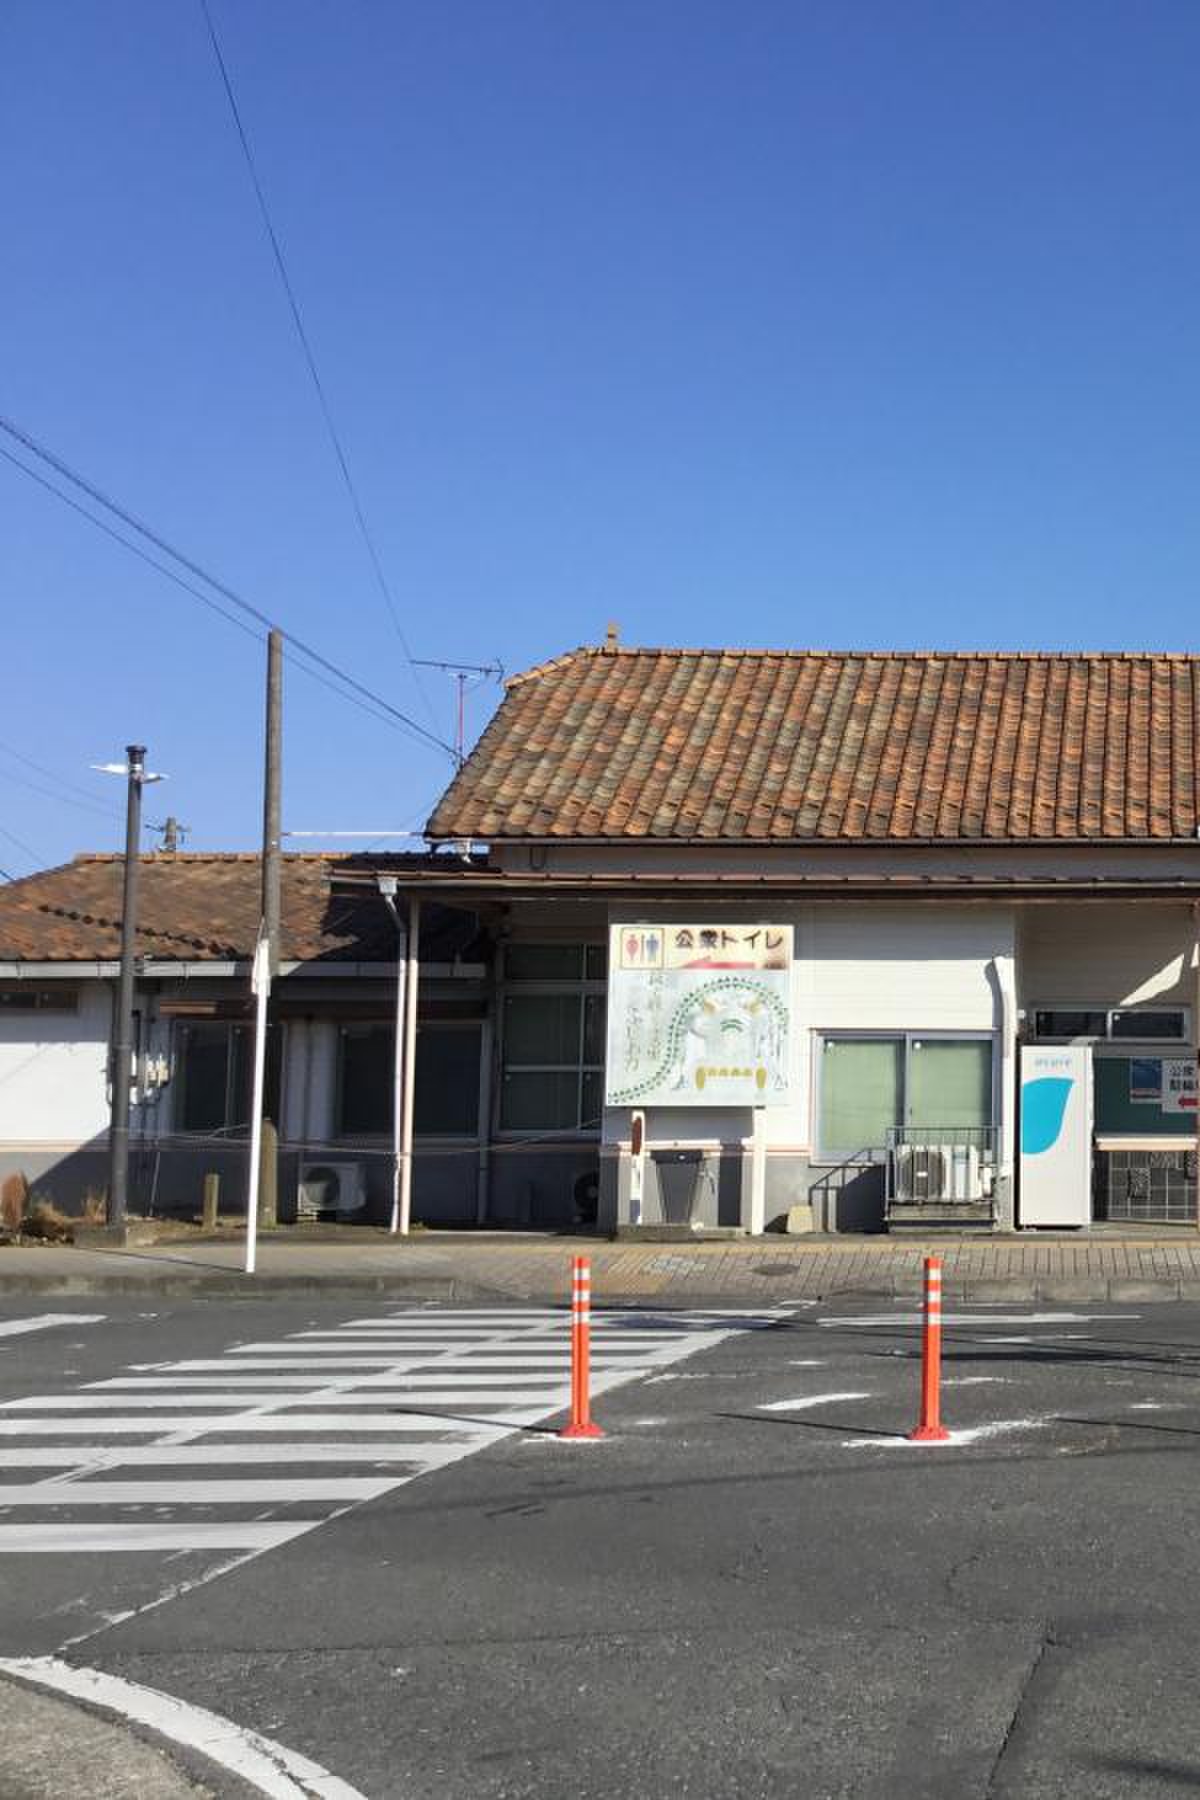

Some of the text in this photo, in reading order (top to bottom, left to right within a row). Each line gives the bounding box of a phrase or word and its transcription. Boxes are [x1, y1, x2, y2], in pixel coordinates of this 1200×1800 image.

[675, 929, 784, 949] 公衆トイレ
